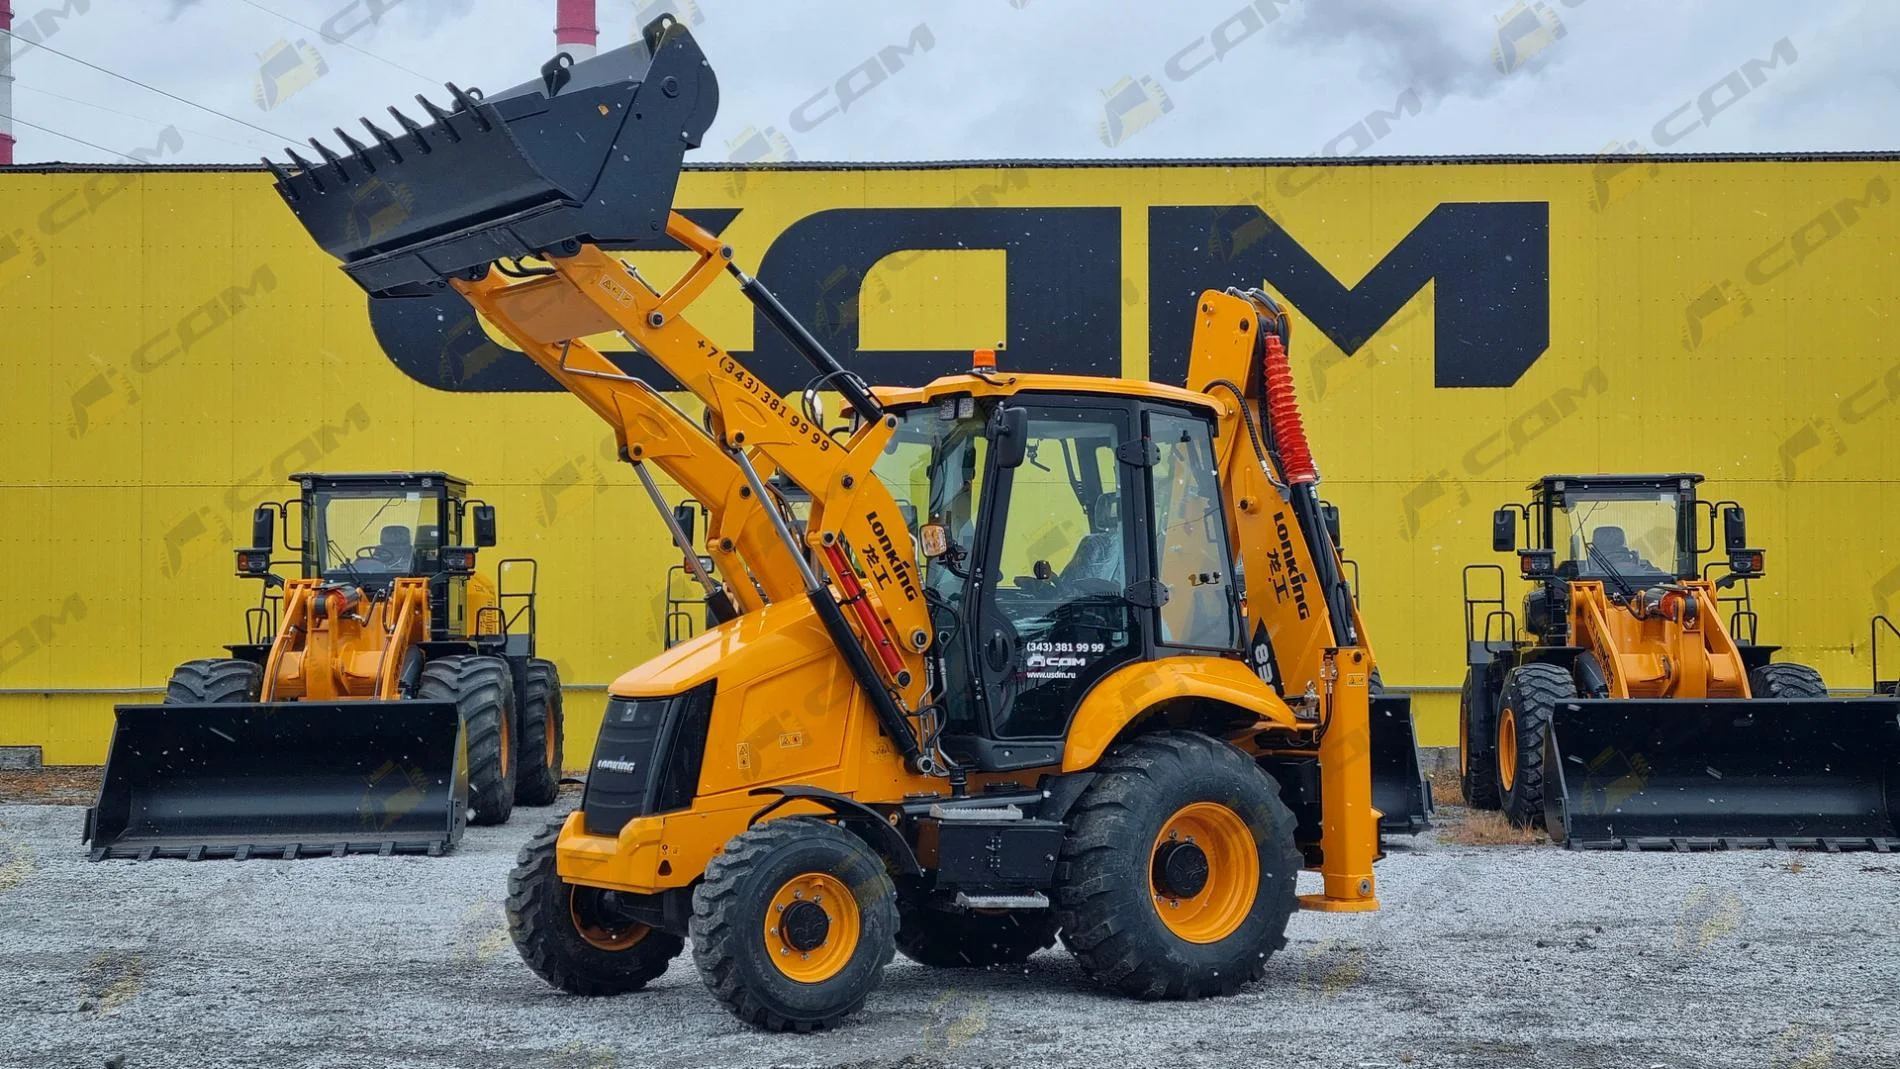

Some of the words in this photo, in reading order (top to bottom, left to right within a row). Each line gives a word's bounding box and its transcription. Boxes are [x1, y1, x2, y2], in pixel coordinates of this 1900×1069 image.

[761, 390, 788, 419] 381
[789, 415, 810, 435] 99
[811, 433, 831, 452] 99
[1026, 642, 1053, 653] (343)
[1054, 642, 1073, 653] 381
[1076, 643, 1089, 653] 99
[1091, 643, 1105, 653] 99
[1026, 671, 1076, 679] www.usdm.ru
